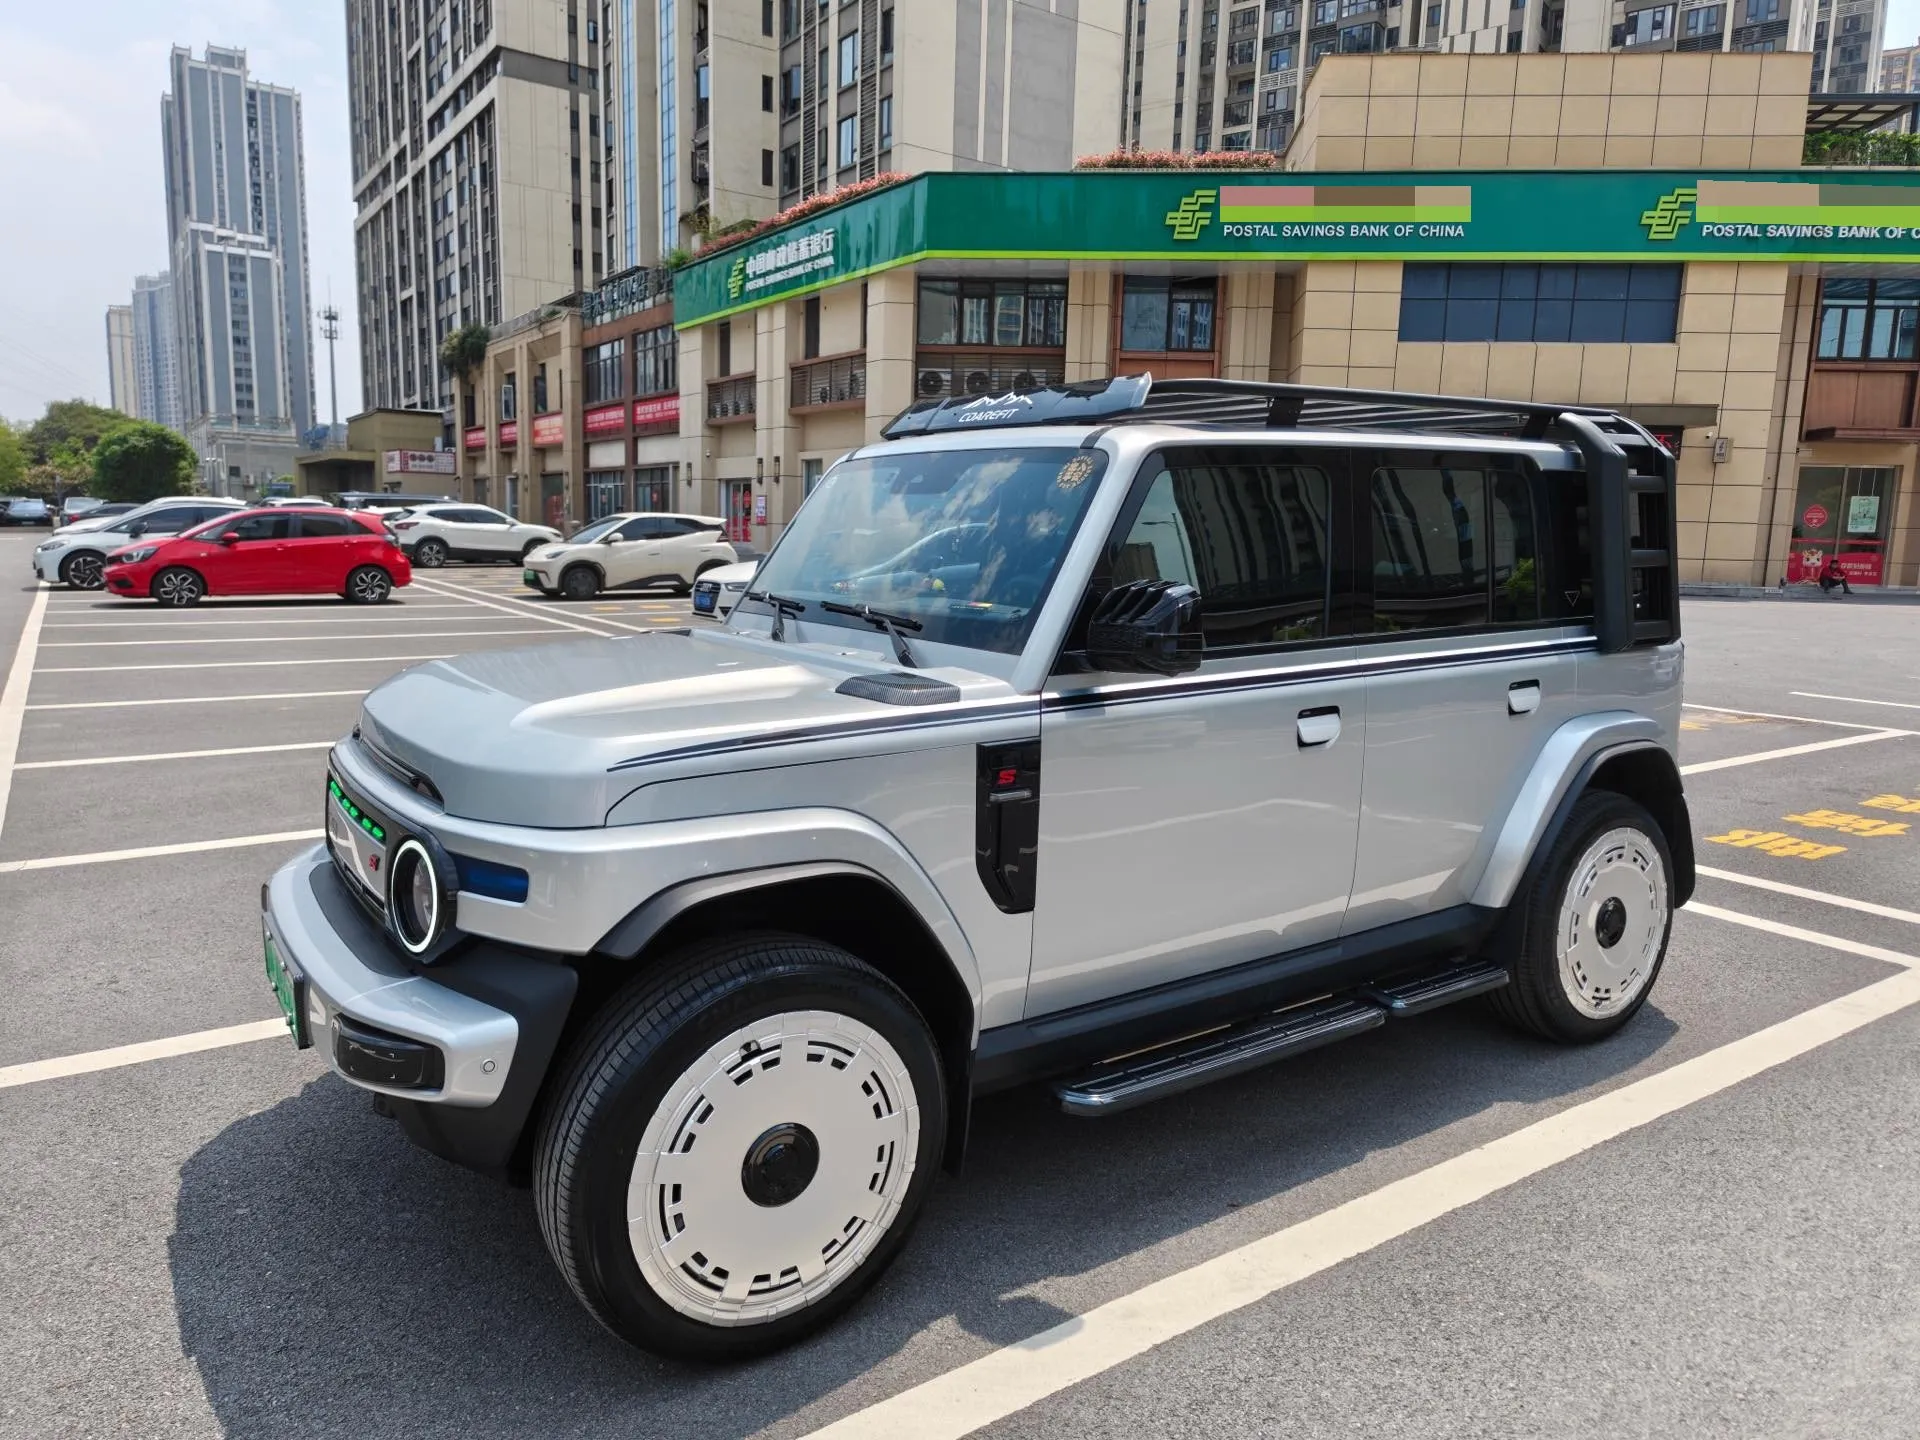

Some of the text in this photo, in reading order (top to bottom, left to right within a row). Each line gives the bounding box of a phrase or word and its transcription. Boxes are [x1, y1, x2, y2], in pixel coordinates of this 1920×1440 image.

[1223, 225, 1464, 237] POSTAL SAVINGS BANK OF CHINA
[1702, 225, 1762, 237] POSTAL
[1766, 225, 1834, 238] SAVINGS
[1838, 226, 1881, 239] BANK
[1885, 227, 1908, 239] OF
[997, 768, 1017, 785] S
